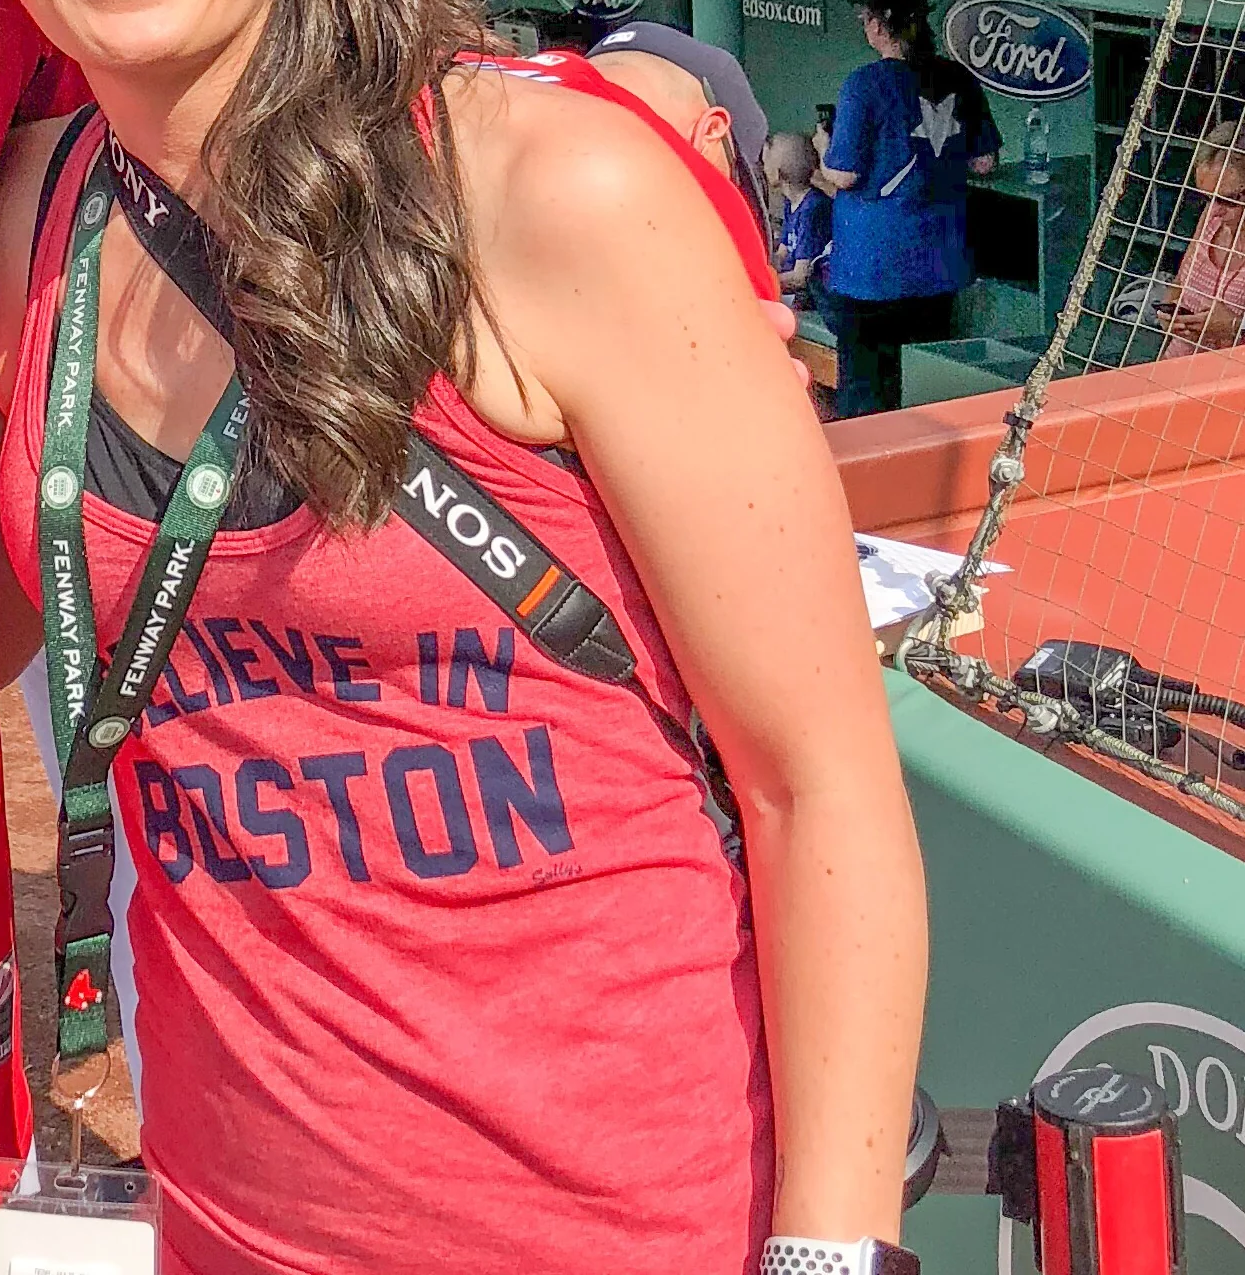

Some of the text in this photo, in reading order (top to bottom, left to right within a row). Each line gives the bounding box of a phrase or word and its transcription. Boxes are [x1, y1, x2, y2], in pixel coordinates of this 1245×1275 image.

[969, 5, 1067, 84] Ford
[109, 128, 170, 228] ONY
[54, 257, 90, 429] FENWAY PARK
[222, 376, 252, 440] FEN
[52, 539, 86, 721] FENWAY PARK
[120, 540, 194, 698] FENWAY PARK
[144, 617, 515, 728] LIEVE IN
[133, 724, 575, 890] BOSTON
[1147, 1044, 1245, 1145] DO
